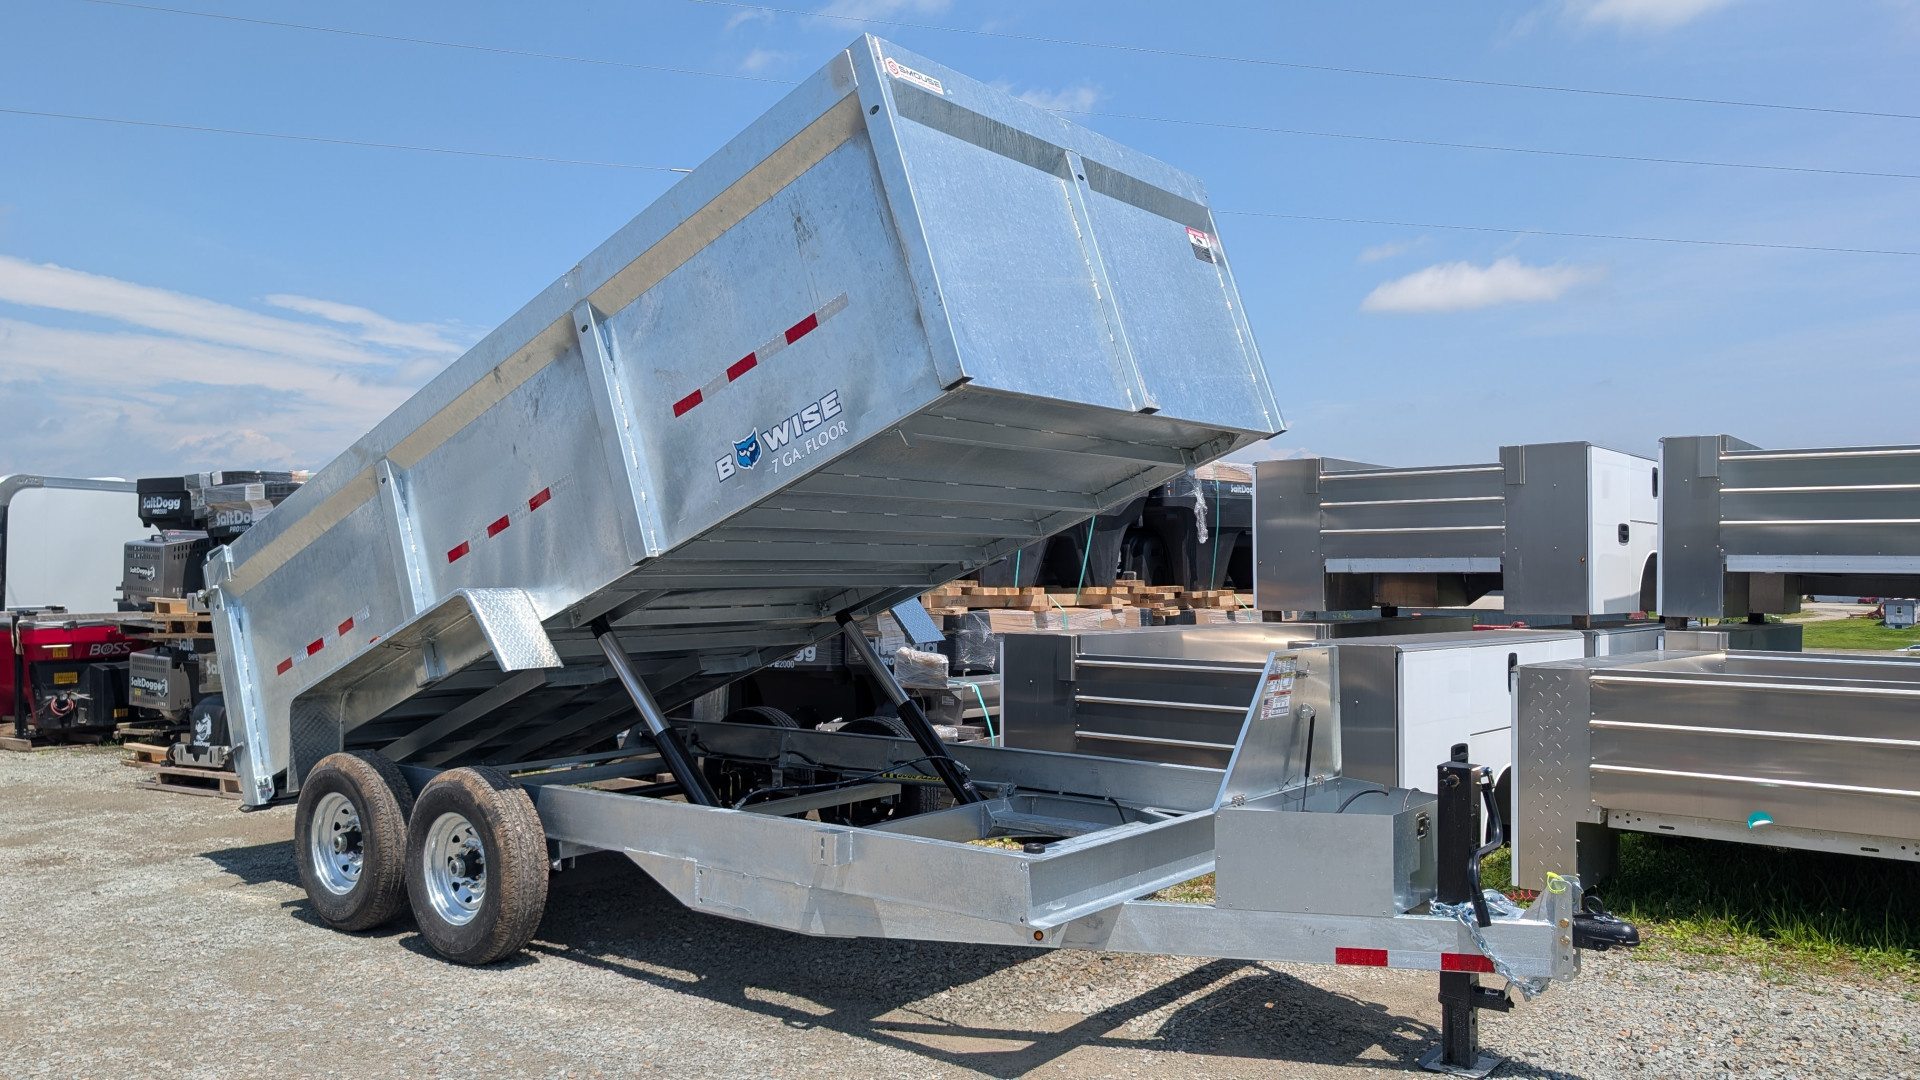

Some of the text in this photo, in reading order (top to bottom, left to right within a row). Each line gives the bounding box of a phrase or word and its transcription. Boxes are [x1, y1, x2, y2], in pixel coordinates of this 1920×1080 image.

[898, 65, 942, 89] SMOUSE
[771, 420, 849, 474] 7 GA. FLOOR
[143, 496, 181, 510] SaltDogg
[216, 510, 252, 527] SaltDo
[89, 642, 132, 656] BOSS
[131, 677, 161, 691] SaltDogg
